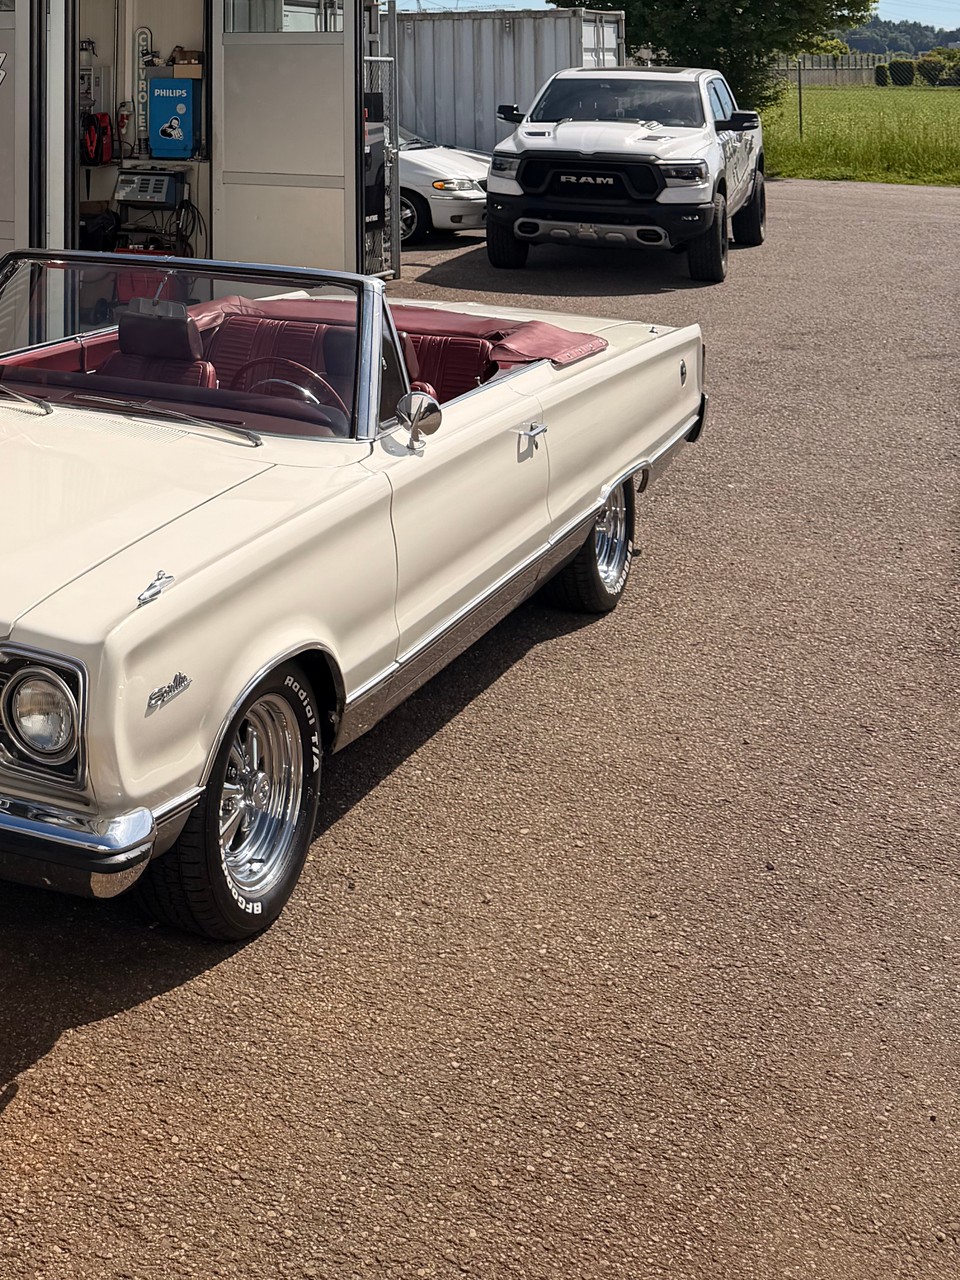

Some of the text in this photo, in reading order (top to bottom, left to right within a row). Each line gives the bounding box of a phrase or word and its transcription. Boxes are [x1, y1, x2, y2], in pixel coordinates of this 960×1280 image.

[154, 89, 188, 98] PHILIPS
[560, 175, 614, 185] RAM
[284, 675, 320, 774] Radial T/A
